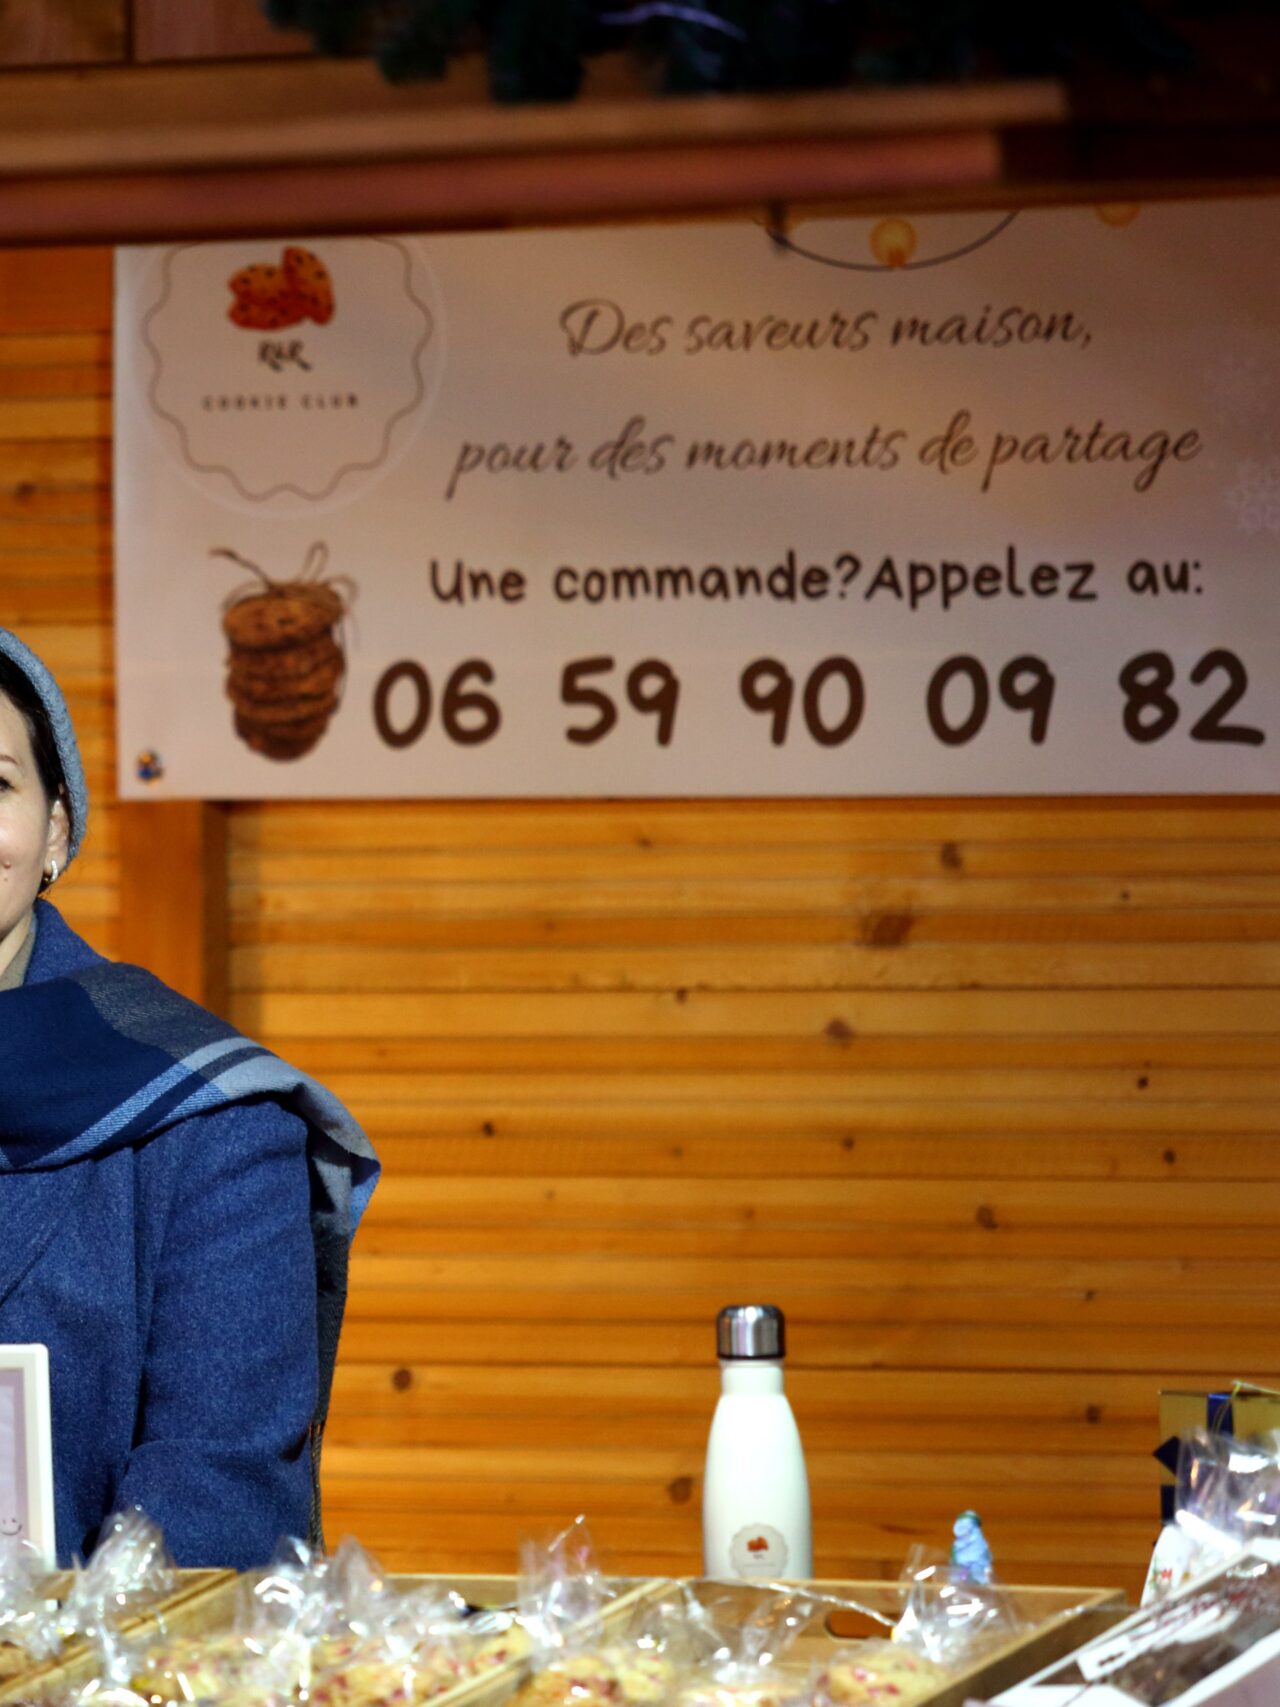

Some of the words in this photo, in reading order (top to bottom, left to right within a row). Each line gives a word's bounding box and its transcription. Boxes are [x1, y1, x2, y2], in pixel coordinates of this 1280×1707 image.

[559, 299, 673, 358] Des
[684, 308, 877, 356] saveurs
[891, 303, 1093, 351] maison,
[445, 433, 578, 501] pour
[588, 414, 676, 481] des
[686, 423, 908, 472] moments
[919, 409, 979, 475] de
[980, 419, 1203, 494] partage
[430, 558, 527, 605] Une
[1126, 557, 1204, 598] au:
[372, 658, 503, 751] 06
[560, 656, 681, 749] 59
[739, 654, 867, 749] 90
[925, 653, 1057, 749] 09
[1117, 648, 1266, 747] 82
